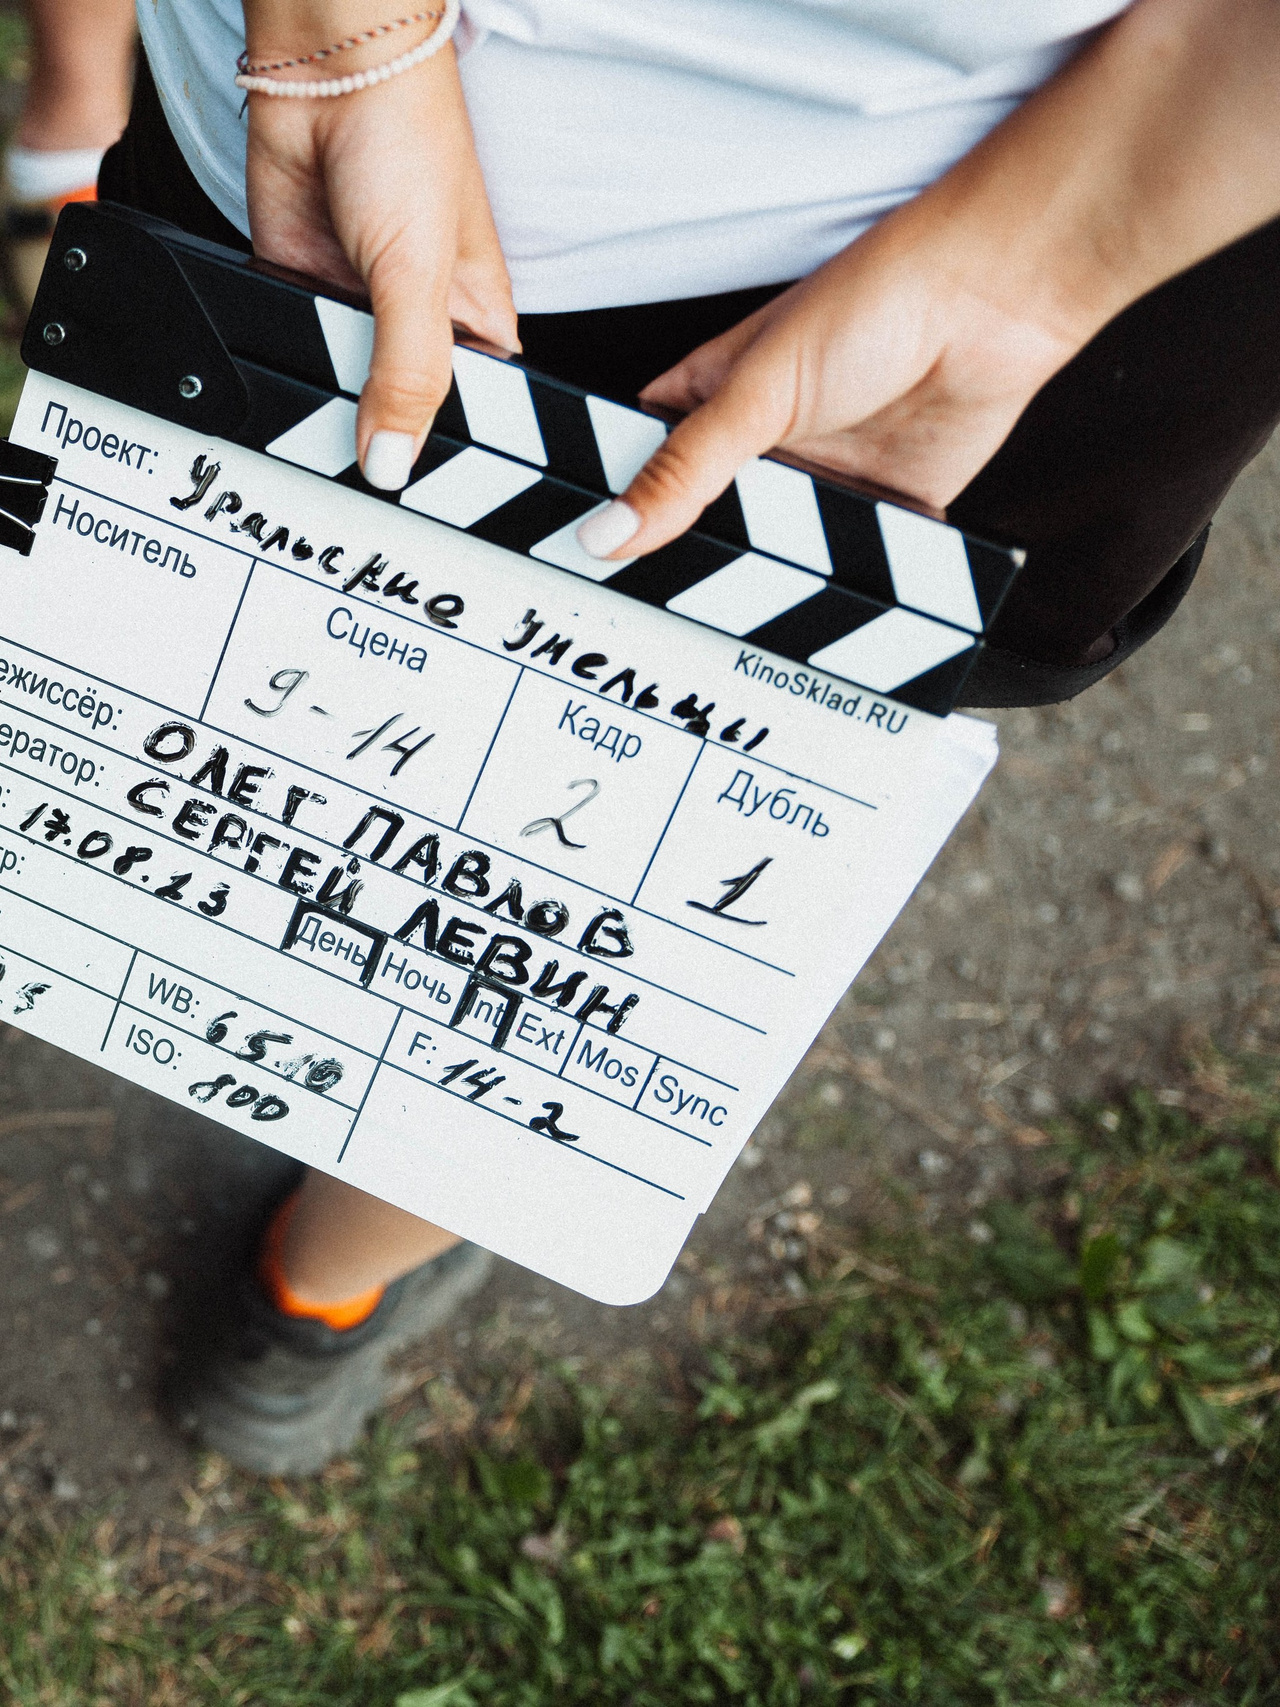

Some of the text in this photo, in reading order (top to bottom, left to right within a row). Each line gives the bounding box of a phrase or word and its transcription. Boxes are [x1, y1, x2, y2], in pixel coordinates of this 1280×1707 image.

[40, 400, 160, 475] Проект:
[51, 493, 198, 580] Носитель
[324, 605, 429, 674] Сцена
[733, 649, 909, 735] KinoSklad.RU
[558, 699, 643, 761] Кадр
[519, 778, 602, 850] 2
[718, 769, 831, 841] Дубль
[142, 720, 636, 960] ОЛЕГ ПАВЛОВ
[126, 776, 640, 1035] СЕРГЕЙ ЛЕВИН
[685, 856, 776, 928] 1
[295, 916, 368, 968] День
[147, 973, 202, 1019] WB:
[381, 952, 454, 1006] Ночь
[124, 1024, 183, 1071] ISO:
[406, 1032, 438, 1066] F:
[517, 1016, 566, 1056] Ext
[577, 1037, 639, 1088] Mos
[188, 1073, 290, 1123] 800
[653, 1073, 729, 1129] Sync
